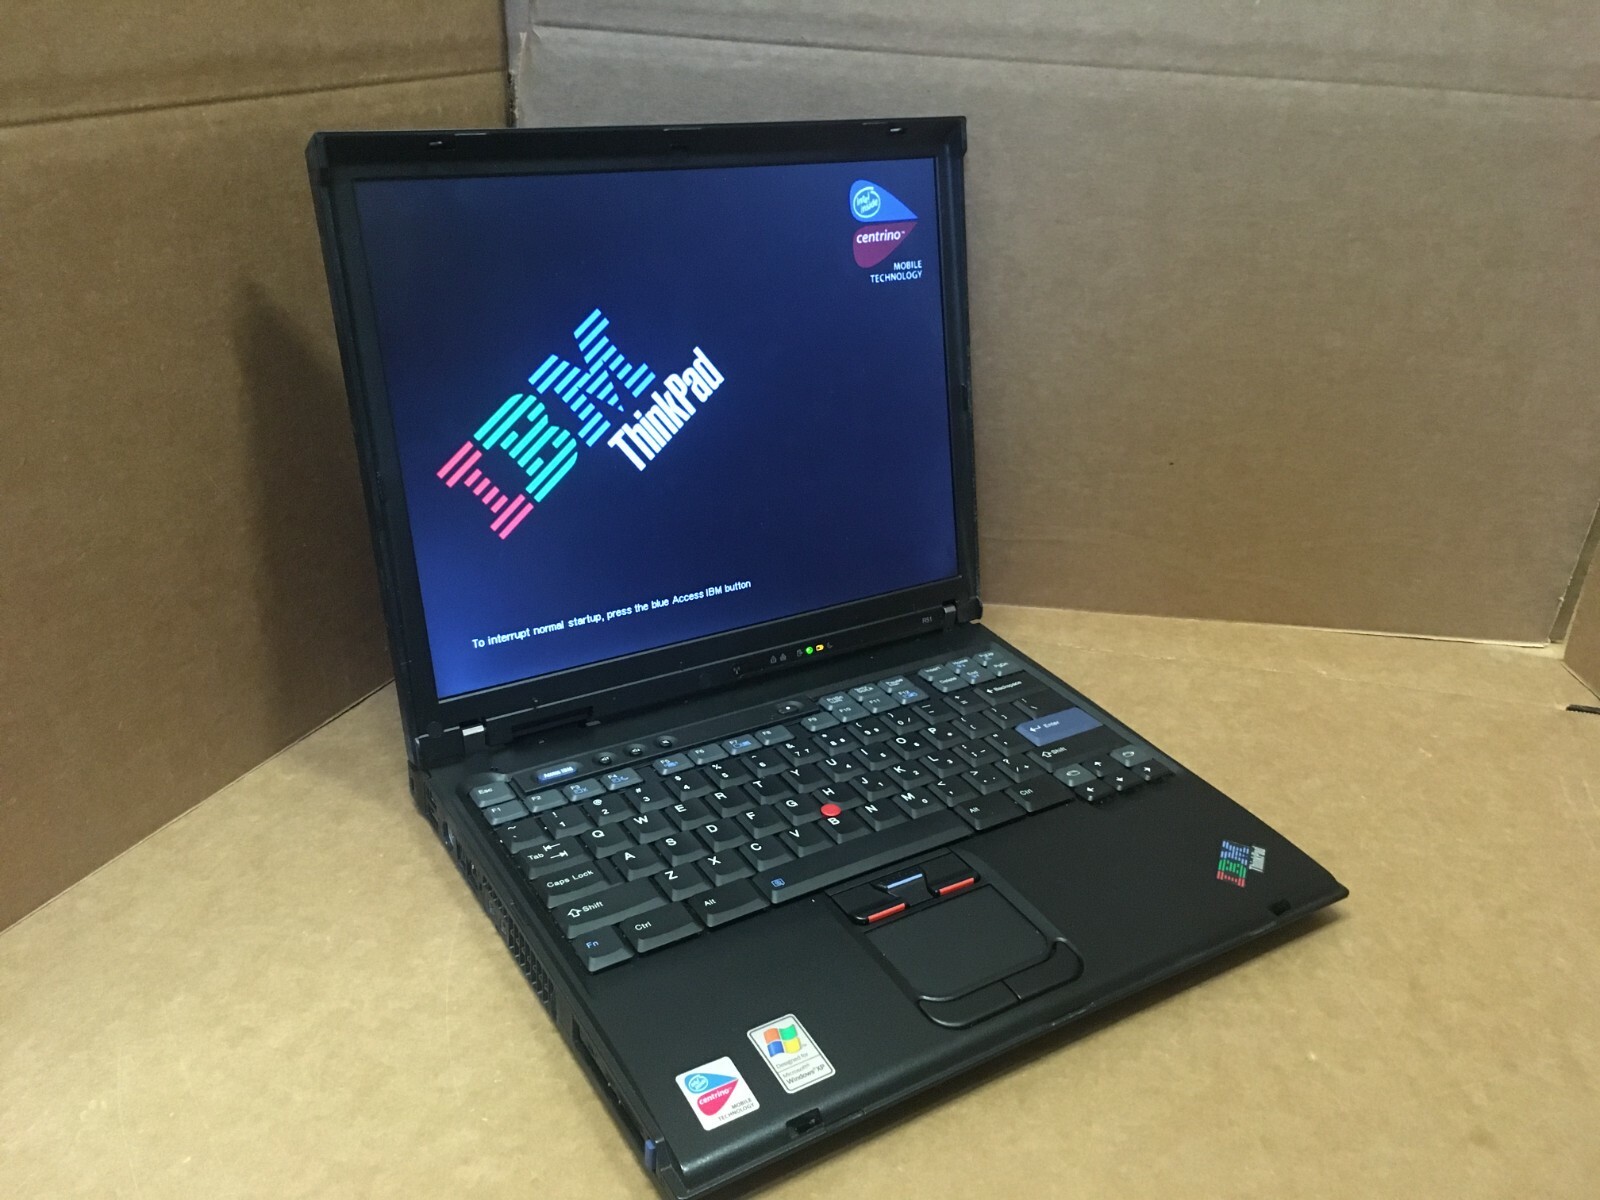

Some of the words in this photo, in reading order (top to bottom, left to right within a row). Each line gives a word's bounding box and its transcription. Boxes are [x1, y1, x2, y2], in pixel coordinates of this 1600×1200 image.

[893, 260, 922, 271] MOBILE
[870, 270, 923, 283] TECHNOLOGY
[607, 346, 725, 472] ThinkPad
[436, 308, 656, 540] IBM
[472, 638, 485, 649] To
[488, 627, 530, 645] interrupt
[533, 620, 564, 636] normal
[568, 613, 605, 628] startup,
[607, 606, 632, 621] press
[634, 602, 649, 613] the
[651, 597, 669, 609] blue
[672, 590, 704, 605] Access
[706, 586, 722, 597] IBM
[725, 580, 751, 594] button
[927, 727, 937, 735] P
[826, 758, 837, 766] U
[790, 769, 800, 777] Y
[893, 766, 906, 774] K
[752, 780, 764, 789] T
[478, 787, 493, 795] Esc
[822, 787, 835, 797] H
[714, 792, 727, 801] R
[901, 792, 915, 802] M
[674, 804, 687, 813] E
[786, 800, 798, 808] G
[865, 805, 878, 814] N
[633, 815, 649, 826] W
[746, 812, 756, 820] F
[827, 817, 840, 825] B
[705, 824, 718, 833] D
[592, 830, 605, 839] Q
[789, 829, 800, 838] V
[665, 838, 677, 847] S
[750, 843, 762, 851] C
[527, 852, 544, 861] Tab
[624, 851, 636, 861] A
[707, 856, 722, 866] X
[546, 877, 570, 889] Caps
[572, 869, 594, 881] Lock
[664, 870, 678, 881] Z
[582, 901, 604, 913] Shift
[635, 921, 652, 931] Ctrl
[586, 940, 599, 949] Fn
[800, 1052, 809, 1061] for
[816, 1063, 825, 1073] XP
[731, 1098, 752, 1109] MOBILE
